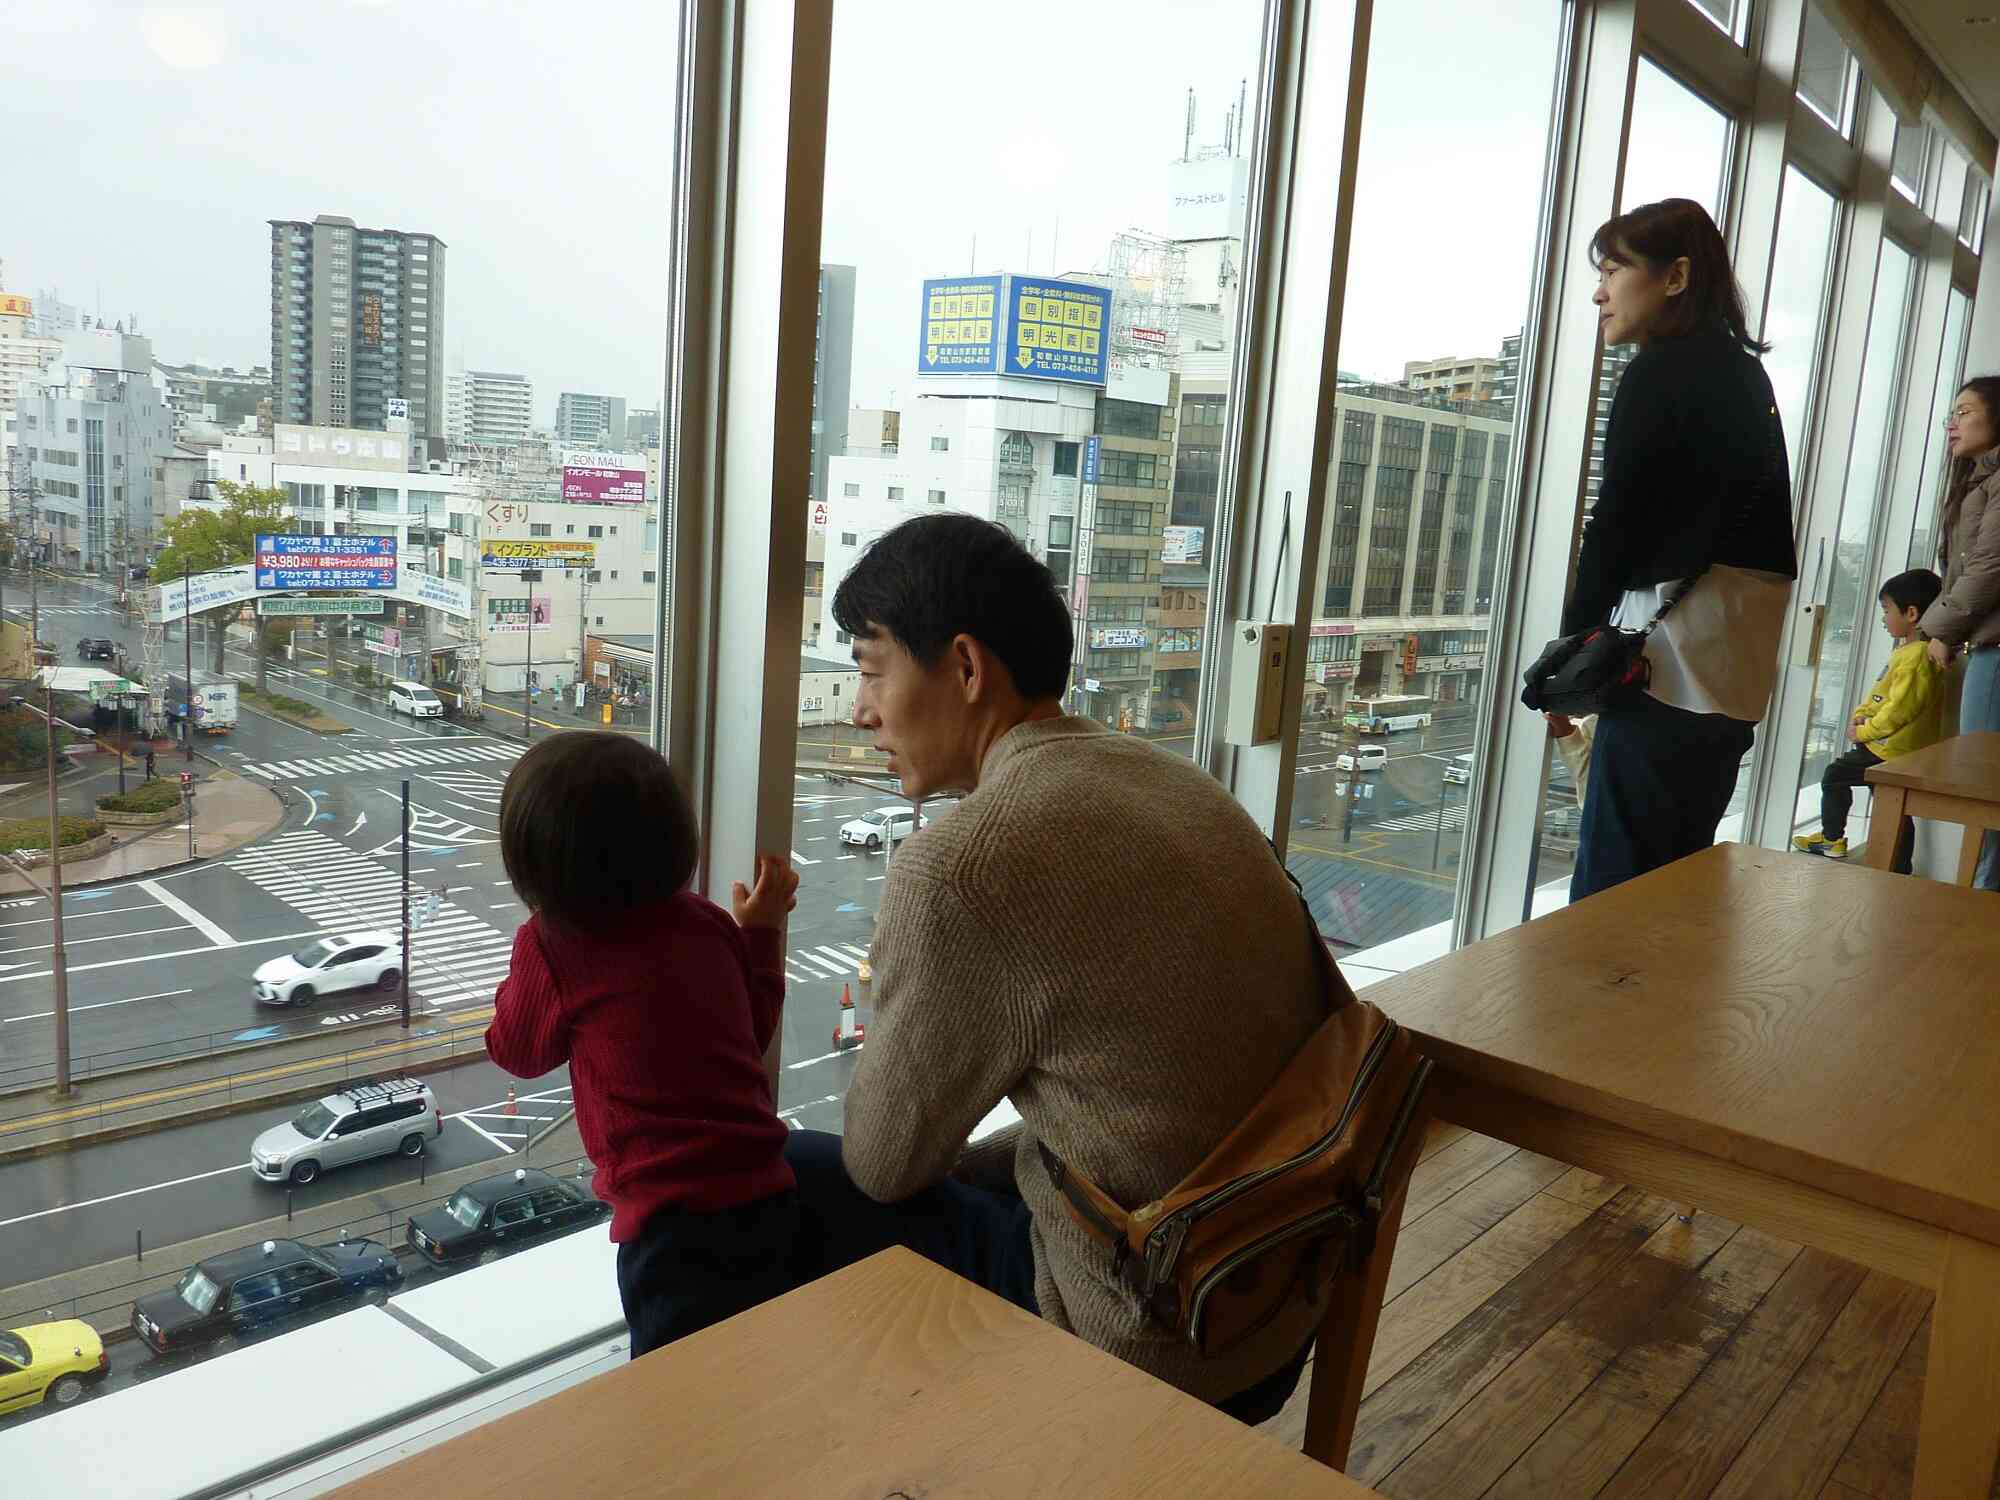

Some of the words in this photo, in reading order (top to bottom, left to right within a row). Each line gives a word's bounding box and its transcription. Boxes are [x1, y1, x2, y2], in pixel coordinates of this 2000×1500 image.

[597, 456, 625, 467] MALL
[487, 503, 528, 523] くすり
[497, 543, 548, 557] インプラント
